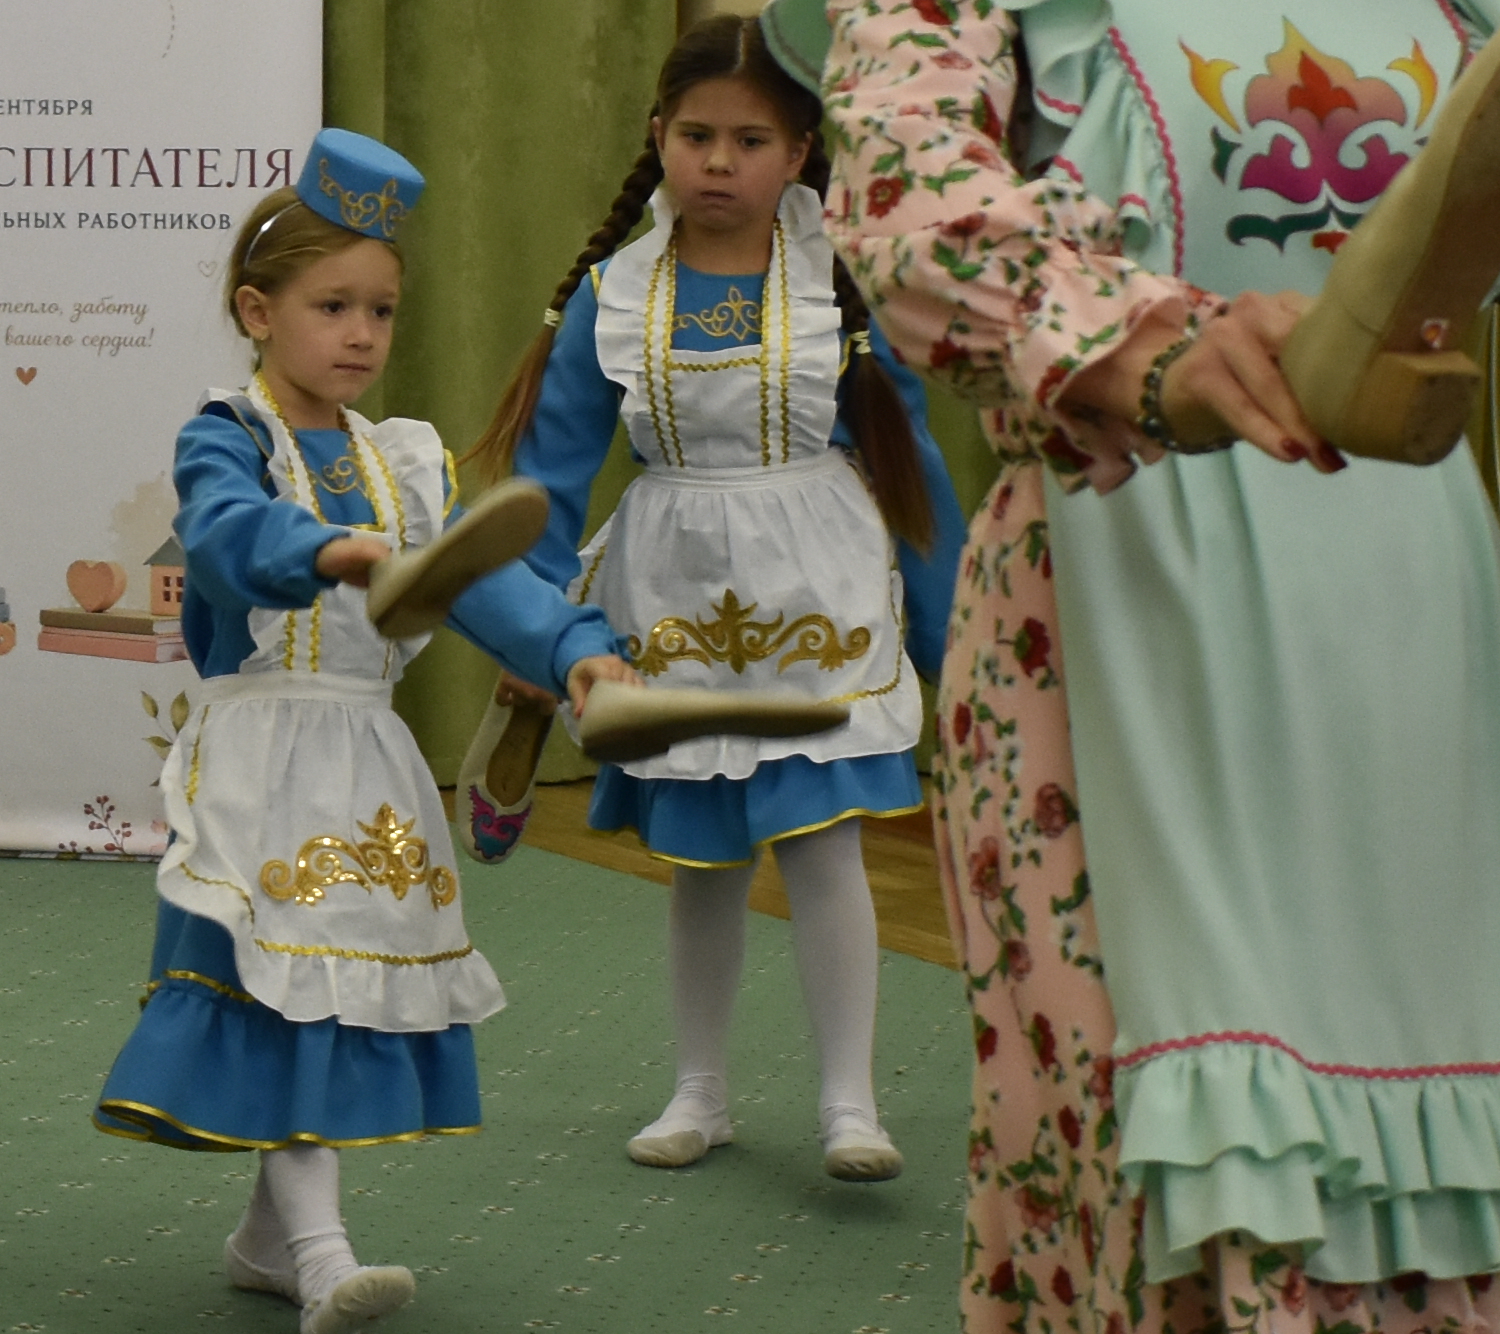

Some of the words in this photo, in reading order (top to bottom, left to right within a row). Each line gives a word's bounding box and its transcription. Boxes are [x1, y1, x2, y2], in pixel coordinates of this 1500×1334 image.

[77, 212, 232, 230] РАБОТНИКОВ
[69, 295, 149, 325] заботу
[4, 325, 76, 347] вашего
